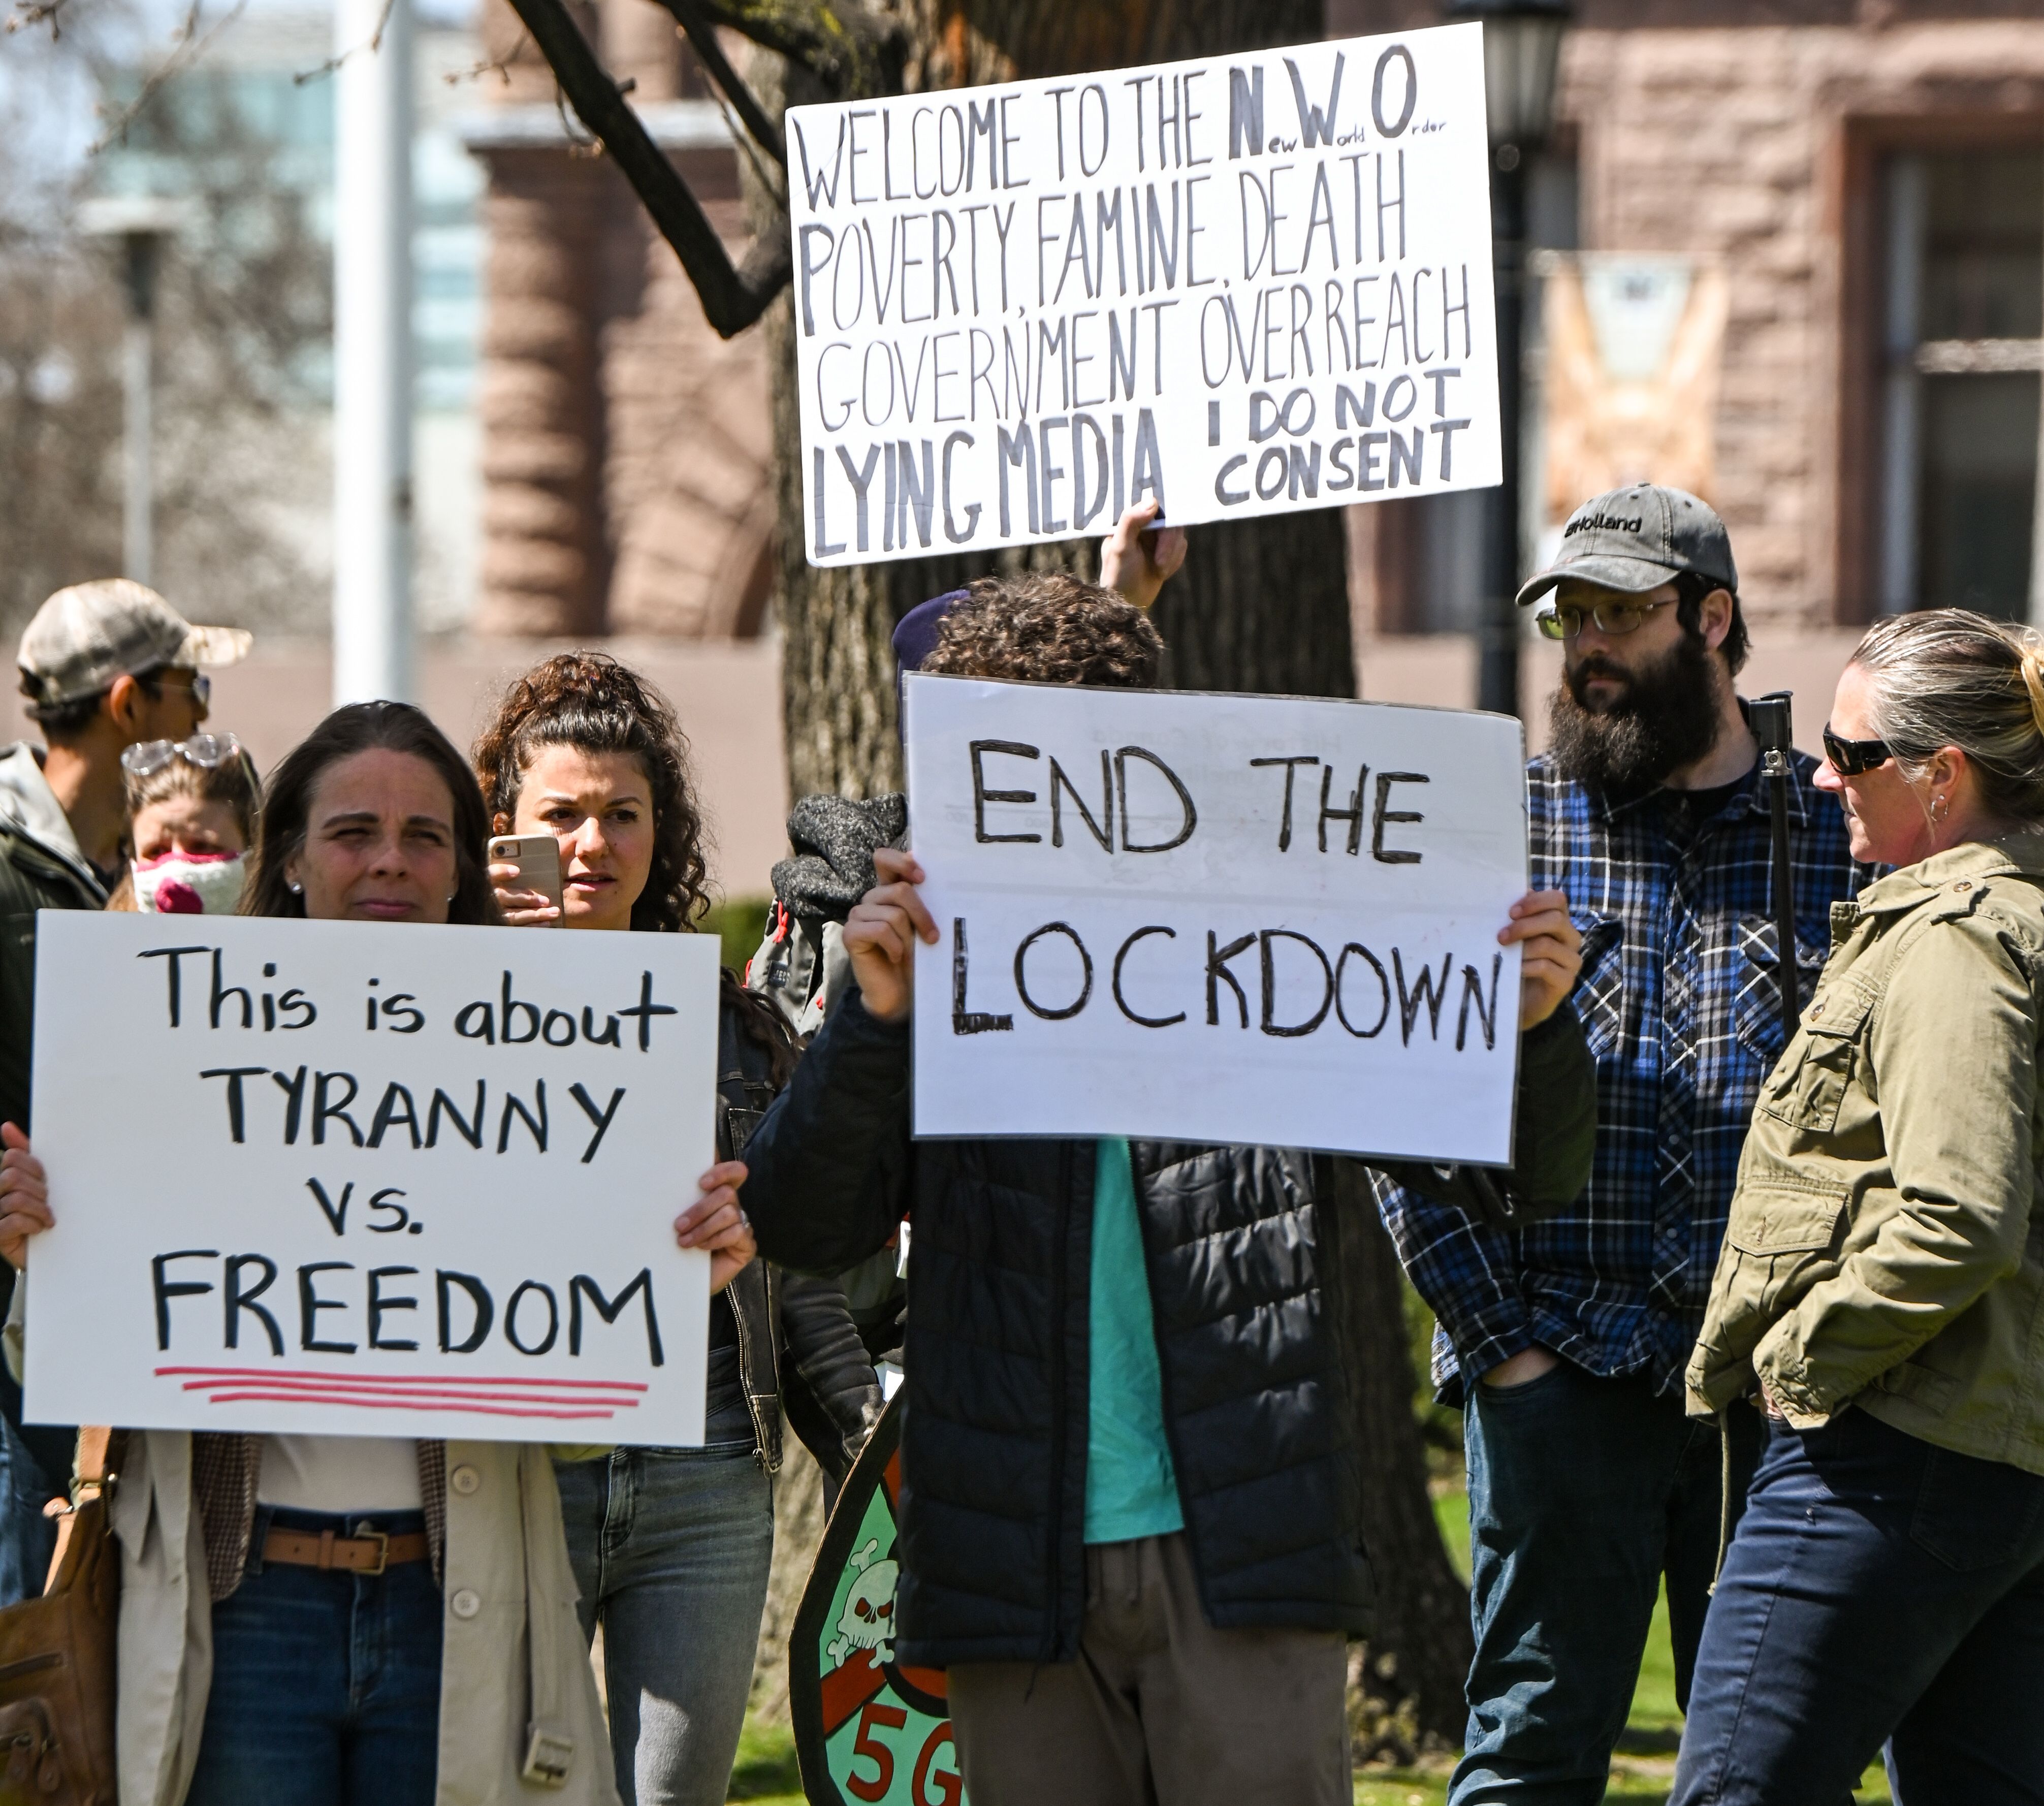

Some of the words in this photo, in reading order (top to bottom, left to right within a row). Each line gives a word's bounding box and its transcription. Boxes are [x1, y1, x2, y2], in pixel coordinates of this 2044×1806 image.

[792, 93, 1031, 212] WELCOME
[1044, 83, 1109, 181] TO
[1124, 69, 1213, 173] THE
[799, 200, 1026, 337] POVERTY,
[1239, 148, 1406, 281] DEATH
[817, 300, 1179, 432] GOVERNMENT
[1208, 400, 1220, 447] I
[1249, 388, 1316, 443] DO
[1334, 368, 1461, 430] NOT
[814, 430, 982, 558] LYING
[997, 407, 1165, 537] MEDIA
[1215, 419, 1472, 506] CONSENT
[969, 739, 1197, 854] END
[1250, 755, 1430, 864] THE
[137, 946, 317, 1032] This
[365, 977, 426, 1034] is
[455, 969, 679, 1053] about
[952, 916, 1502, 1052] LOCKDOWN
[199, 1064, 627, 1164] TYRANNY
[151, 1249, 664, 1368] FREEDOM
[845, 1702, 964, 1806] 5G
